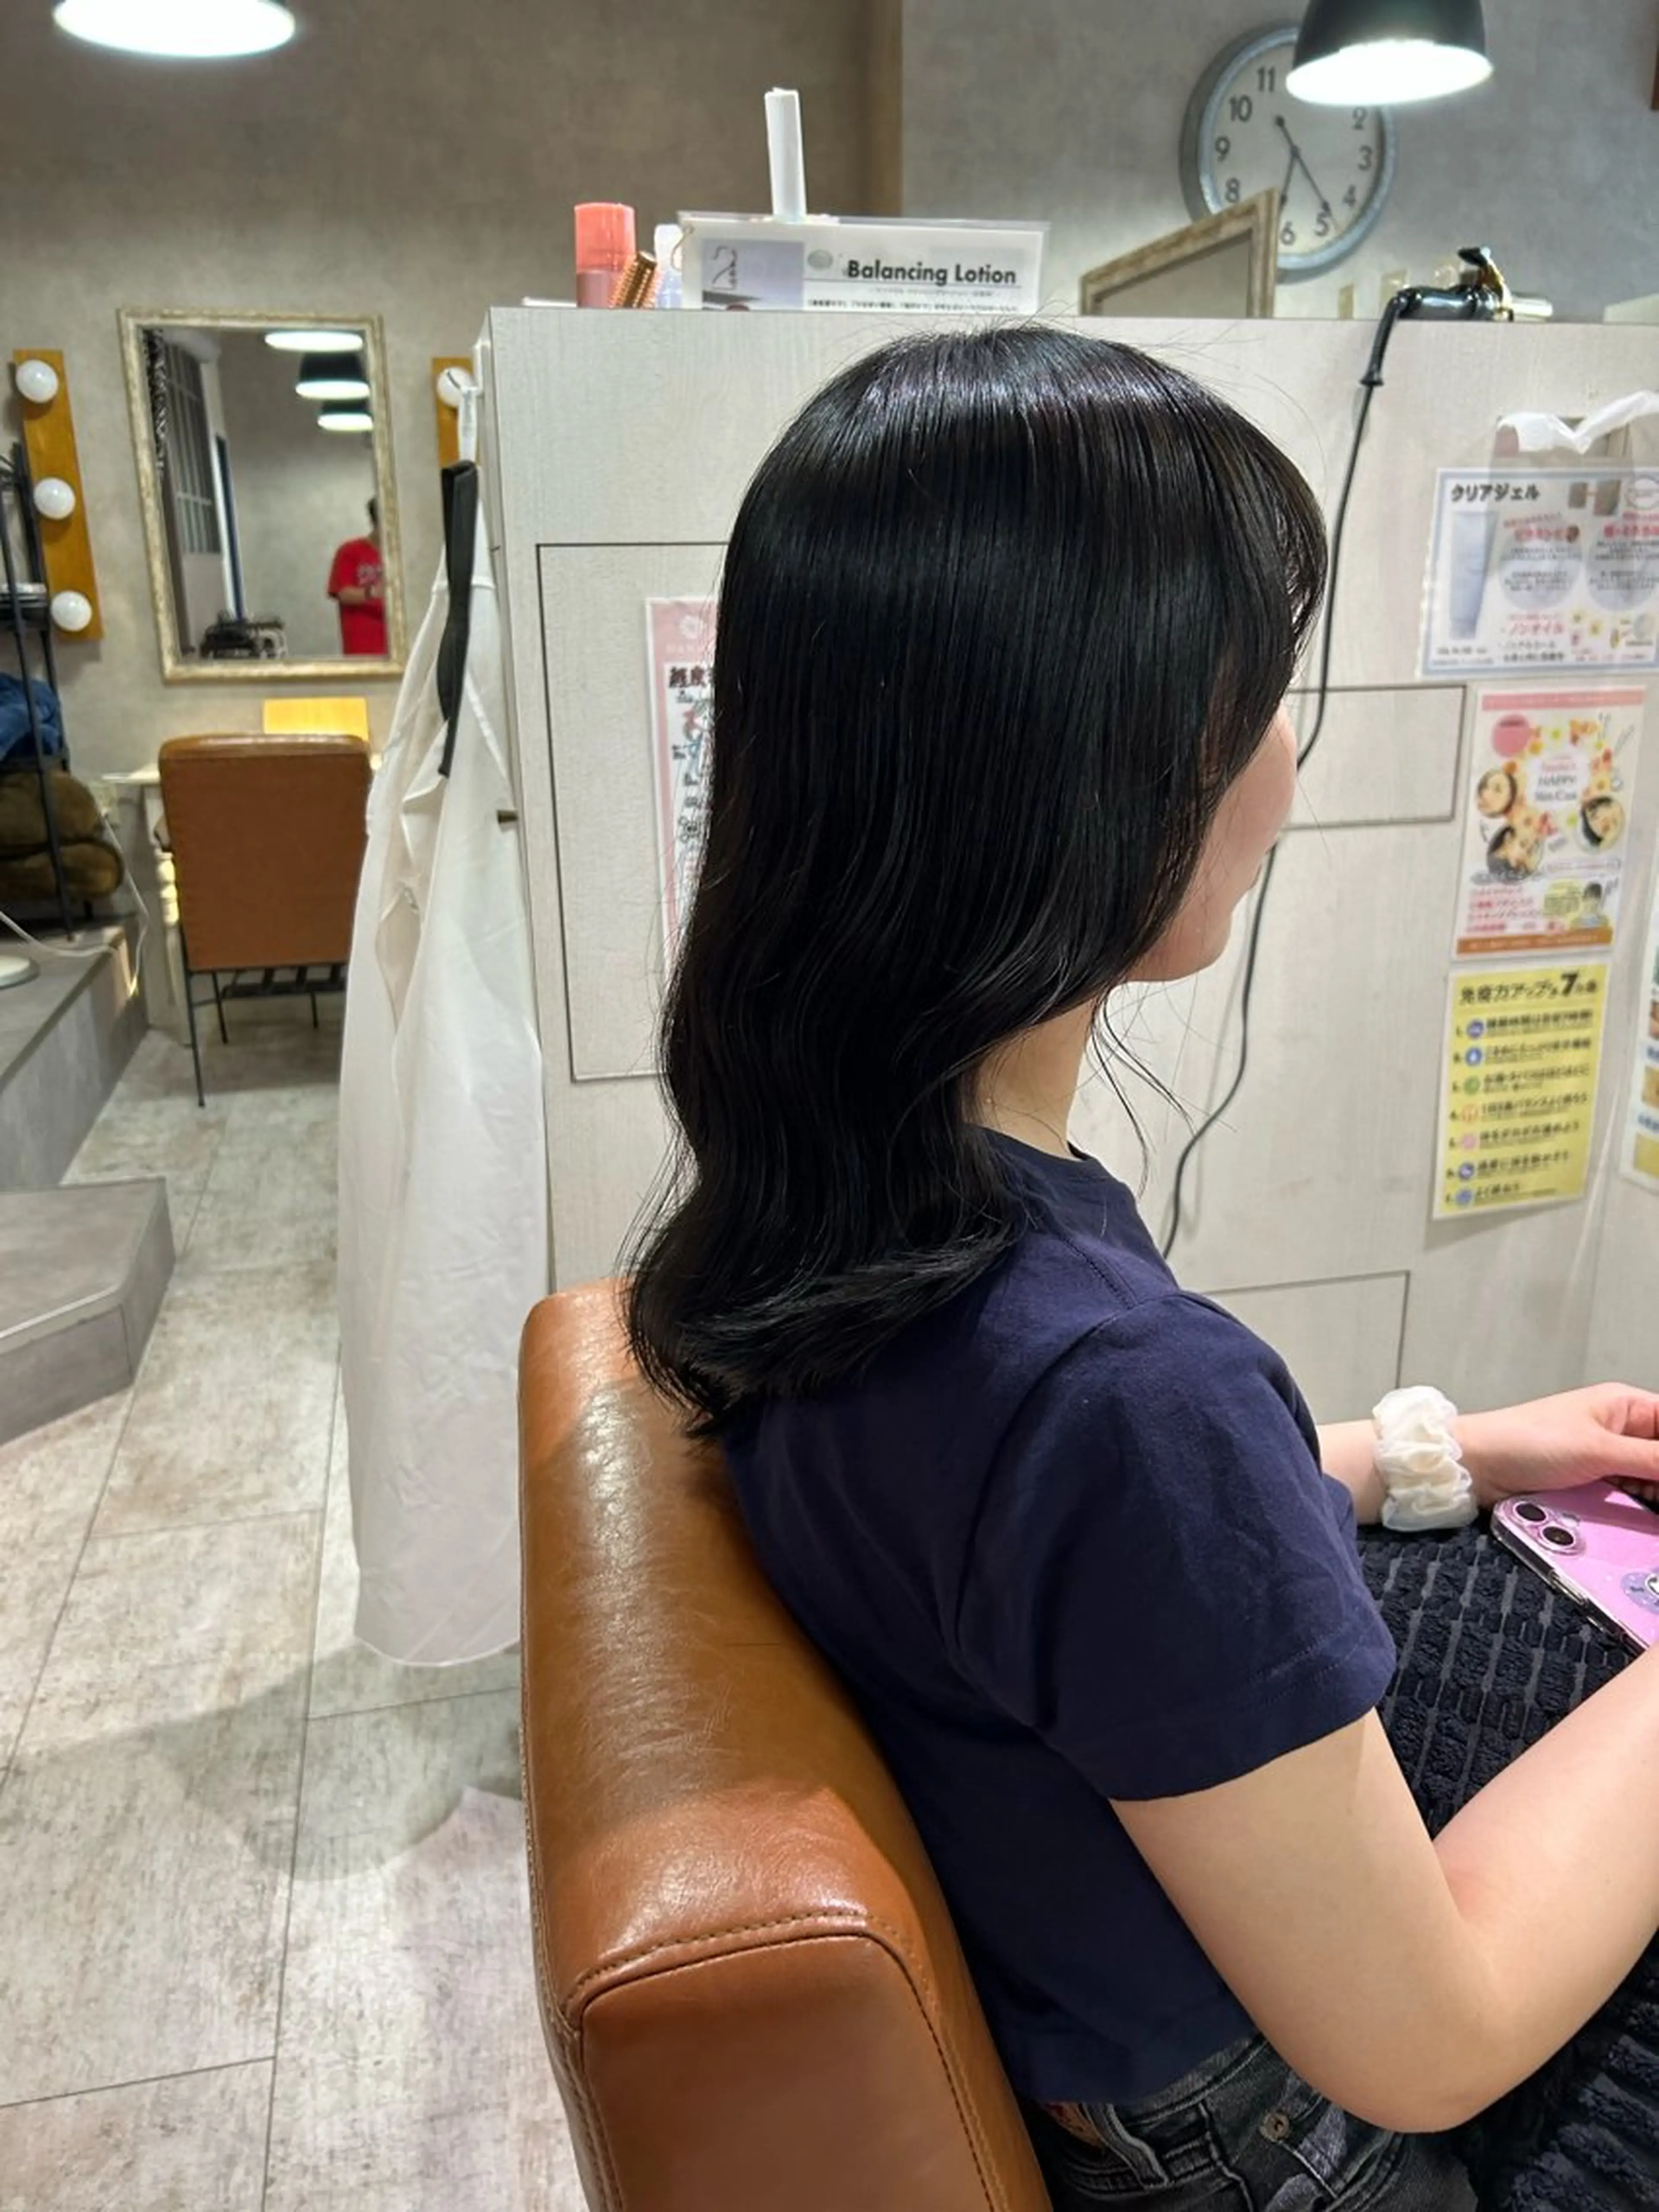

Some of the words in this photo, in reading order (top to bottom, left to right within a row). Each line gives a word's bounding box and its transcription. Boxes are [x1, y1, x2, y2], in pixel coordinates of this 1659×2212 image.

[1257, 67, 1275, 92] 11
[1230, 95, 1252, 122] 10
[1353, 108, 1367, 130] 2
[1215, 136, 1230, 162] 9
[1358, 145, 1372, 170] 3
[1225, 178, 1240, 203] 8
[1344, 184, 1356, 207] 4
[1280, 222, 1296, 246] 6
[1315, 212, 1329, 237] 5
[847, 259, 948, 286] Balancing
[955, 264, 1016, 284] Lotion
[1451, 483, 1541, 502] クリアジェル
